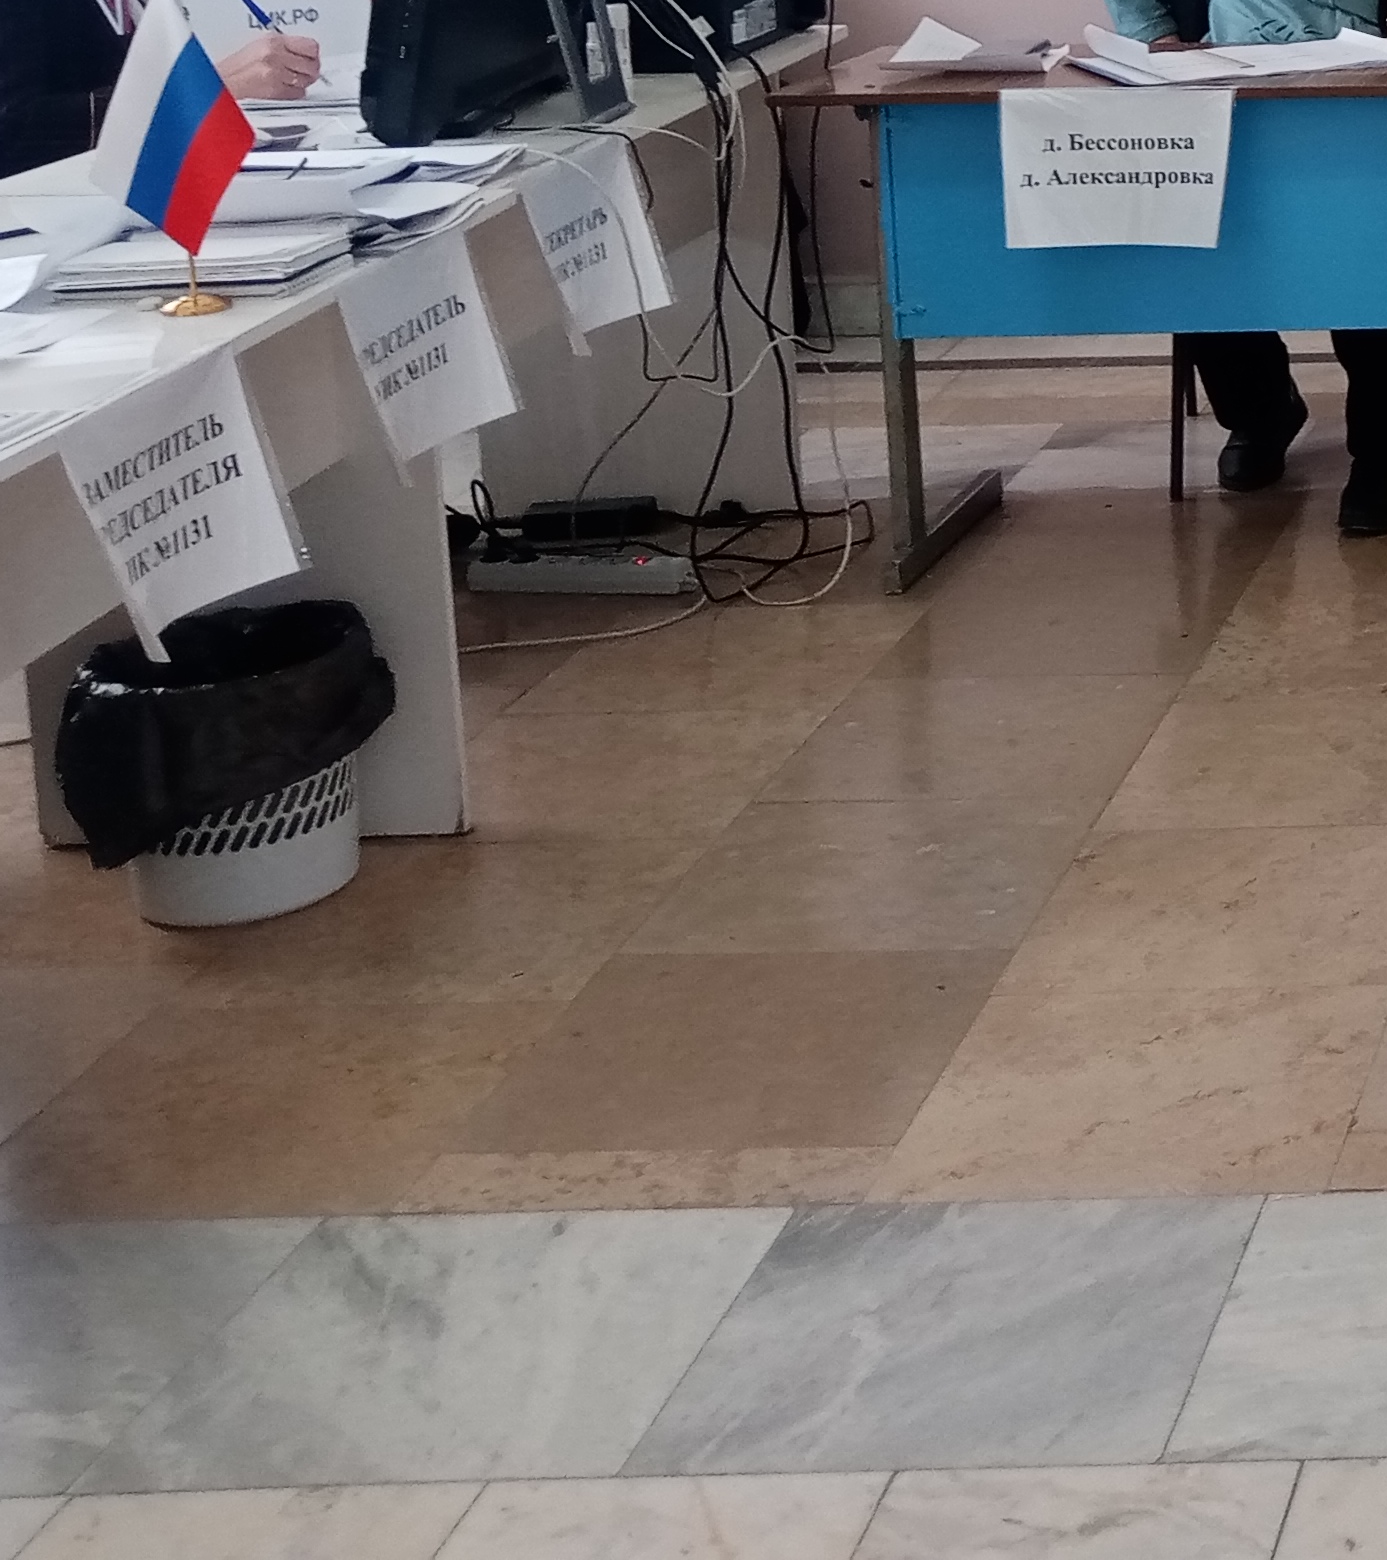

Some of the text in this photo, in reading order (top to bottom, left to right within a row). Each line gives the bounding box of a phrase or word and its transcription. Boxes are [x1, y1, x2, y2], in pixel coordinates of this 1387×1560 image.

[1042, 133, 1195, 152] д. Бессоновка
[1020, 169, 1214, 188] д. Александровка
